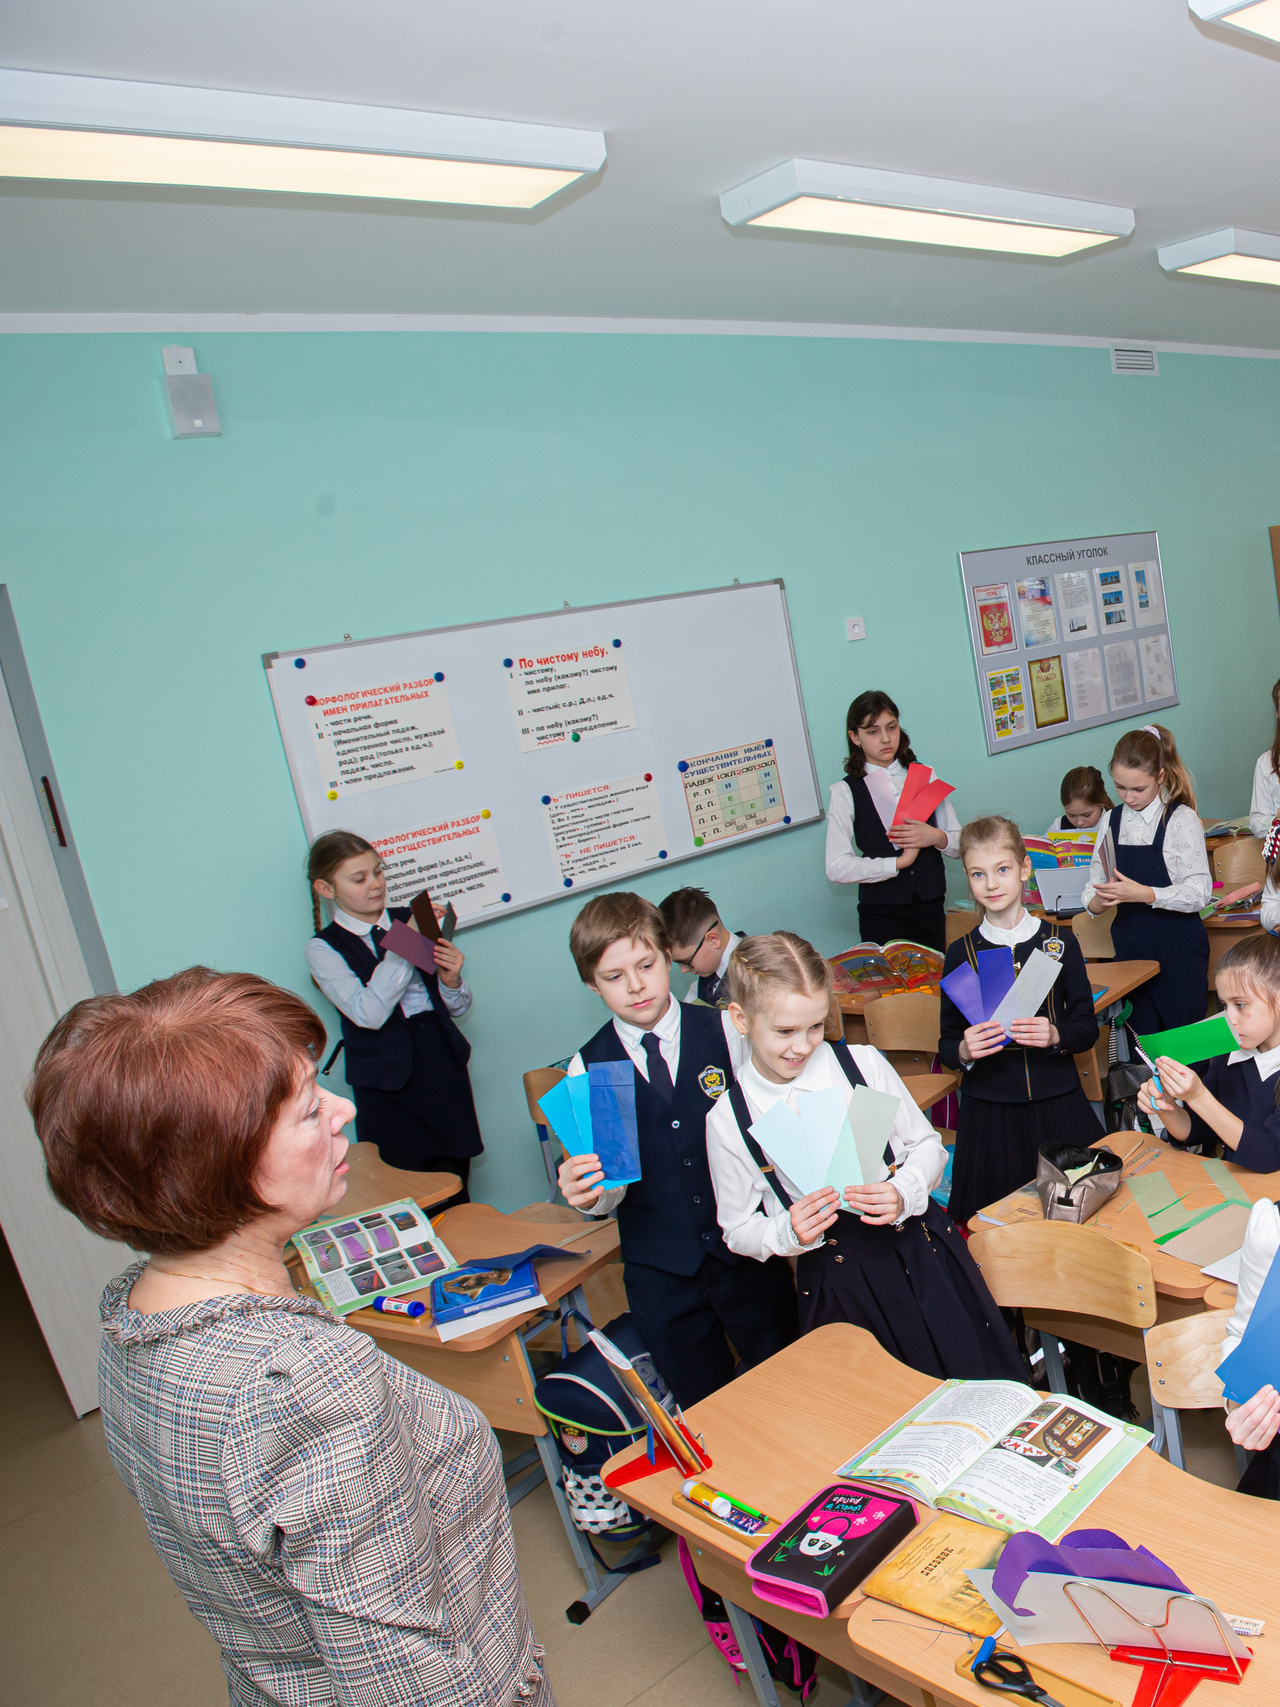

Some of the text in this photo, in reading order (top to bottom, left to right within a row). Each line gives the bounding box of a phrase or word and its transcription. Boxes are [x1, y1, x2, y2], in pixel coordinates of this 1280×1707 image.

[1026, 547, 1108, 565] КЛАССНЫЙ УГОЛОК
[519, 646, 608, 669] По чистому небу.
[536, 675, 552, 684] небу
[554, 670, 588, 682] (какому?)
[590, 665, 617, 674] чистому
[403, 678, 435, 691] РАЗБОР
[323, 690, 429, 717] ИМЕН ПРИЛАГАТЕЛЬНЫХ
[330, 718, 351, 726] части
[333, 724, 372, 736] начальная
[374, 719, 398, 729] форма
[536, 731, 565, 741] чистому
[572, 720, 617, 733] определение
[547, 721, 563, 730] небу
[565, 714, 598, 727] (какому?)
[336, 741, 388, 757] единственное
[414, 728, 445, 740] мужской
[360, 753, 375, 763] род
[684, 751, 772, 779] СУЩЕСТВИТЕЛЬНЫХ
[687, 751, 738, 768] КОНЧАНИЯ
[344, 777, 362, 785] член
[685, 776, 714, 789] ПАДЕЖ
[566, 784, 611, 800] ПИШЕТСЯ:
[371, 815, 480, 850] ОРФОЛОГИЧЕСКИЙ РАЗБОР
[379, 826, 480, 858] МЕН СУЩЕСТВИТЕЛЬНЫХ
[594, 835, 637, 851] ПИШЕТСЯ:
[417, 862, 438, 873] форма
[921, 1547, 954, 1576] ДНЕВНИК
